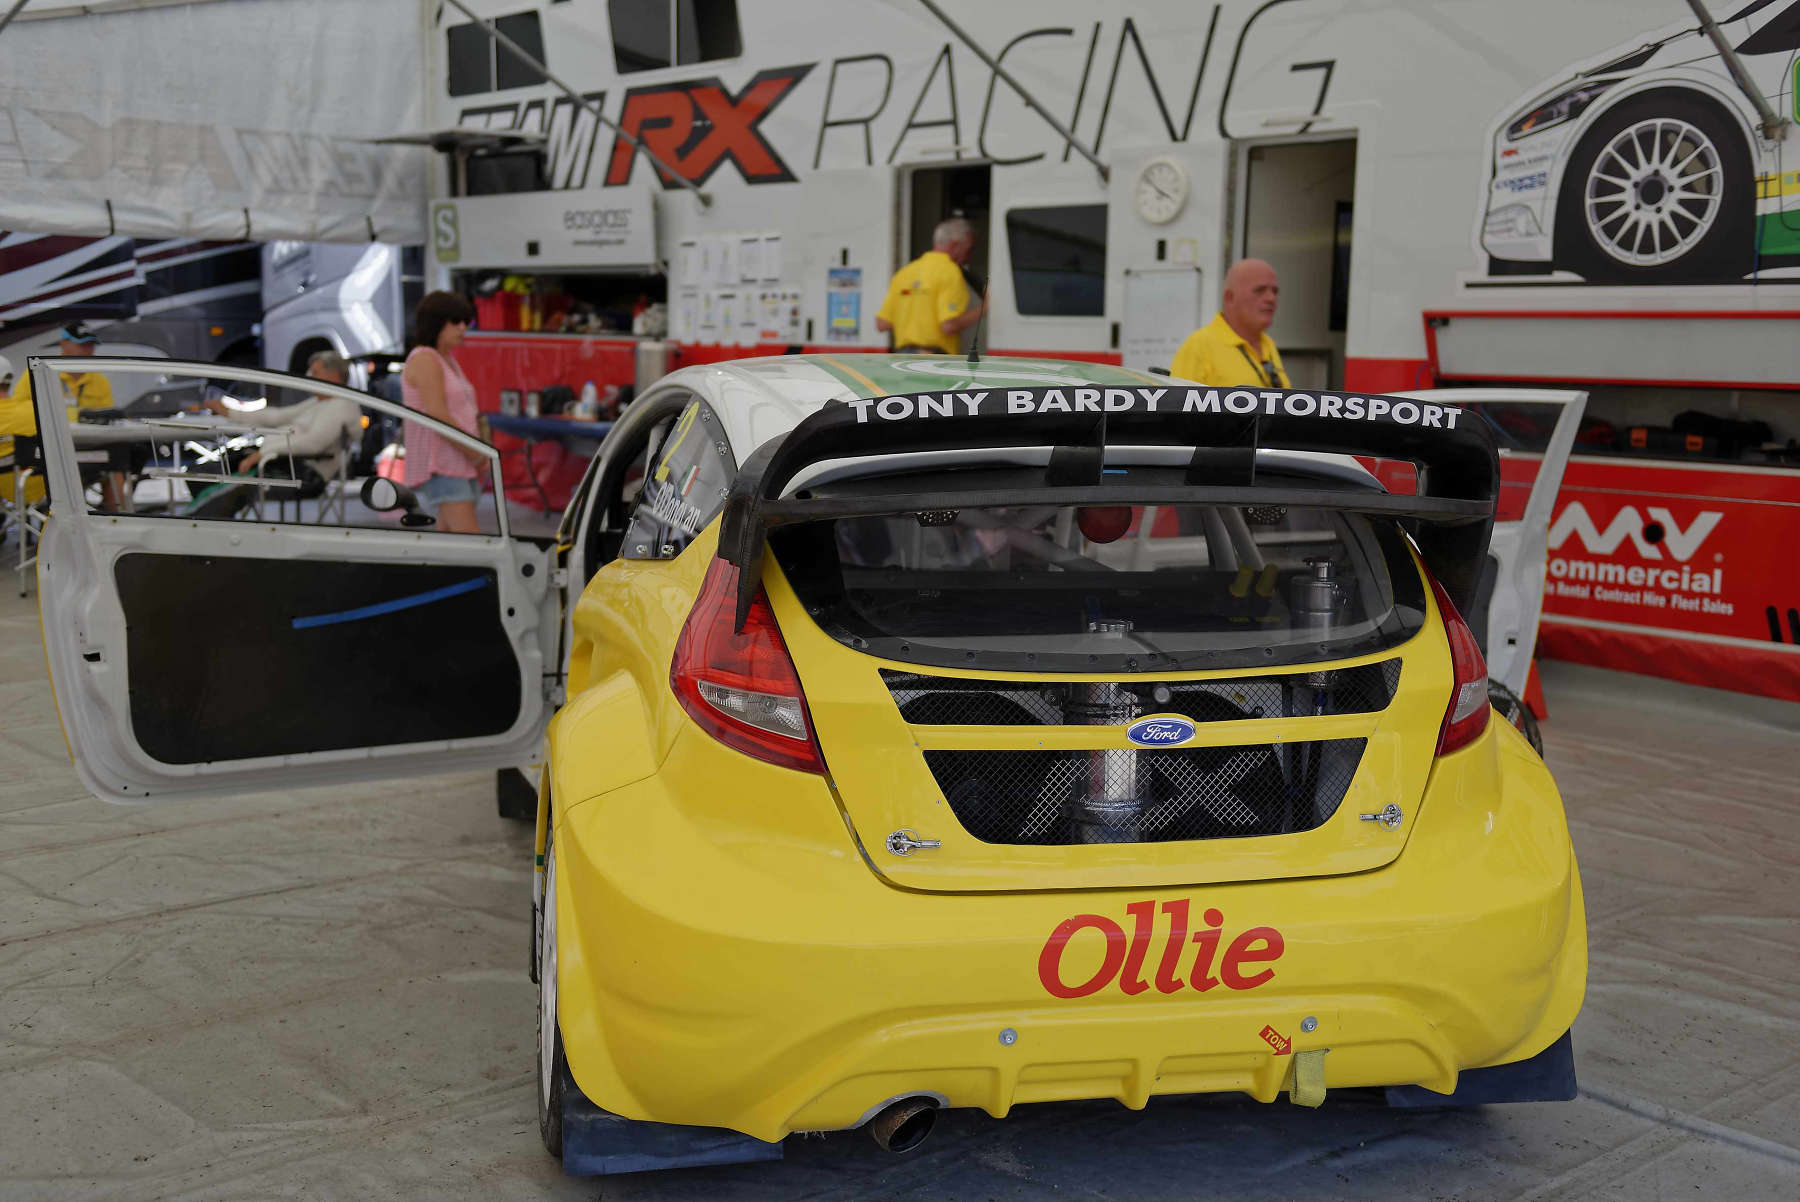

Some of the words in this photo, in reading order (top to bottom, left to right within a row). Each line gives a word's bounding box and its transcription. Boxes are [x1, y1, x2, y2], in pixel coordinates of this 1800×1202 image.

[603, 63, 820, 190] RX
[814, 0, 1336, 169] RACING
[848, 391, 990, 424] TONY
[1007, 388, 1168, 415] BARDY
[1182, 389, 1462, 430] MOTORSPORT
[1546, 558, 1723, 594] ommercial
[1594, 585, 1641, 606] Contract
[1702, 598, 1734, 616] Sales
[1141, 723, 1182, 741] Ford
[1037, 898, 1285, 999] Ollie
[1264, 1029, 1288, 1051] TOW
